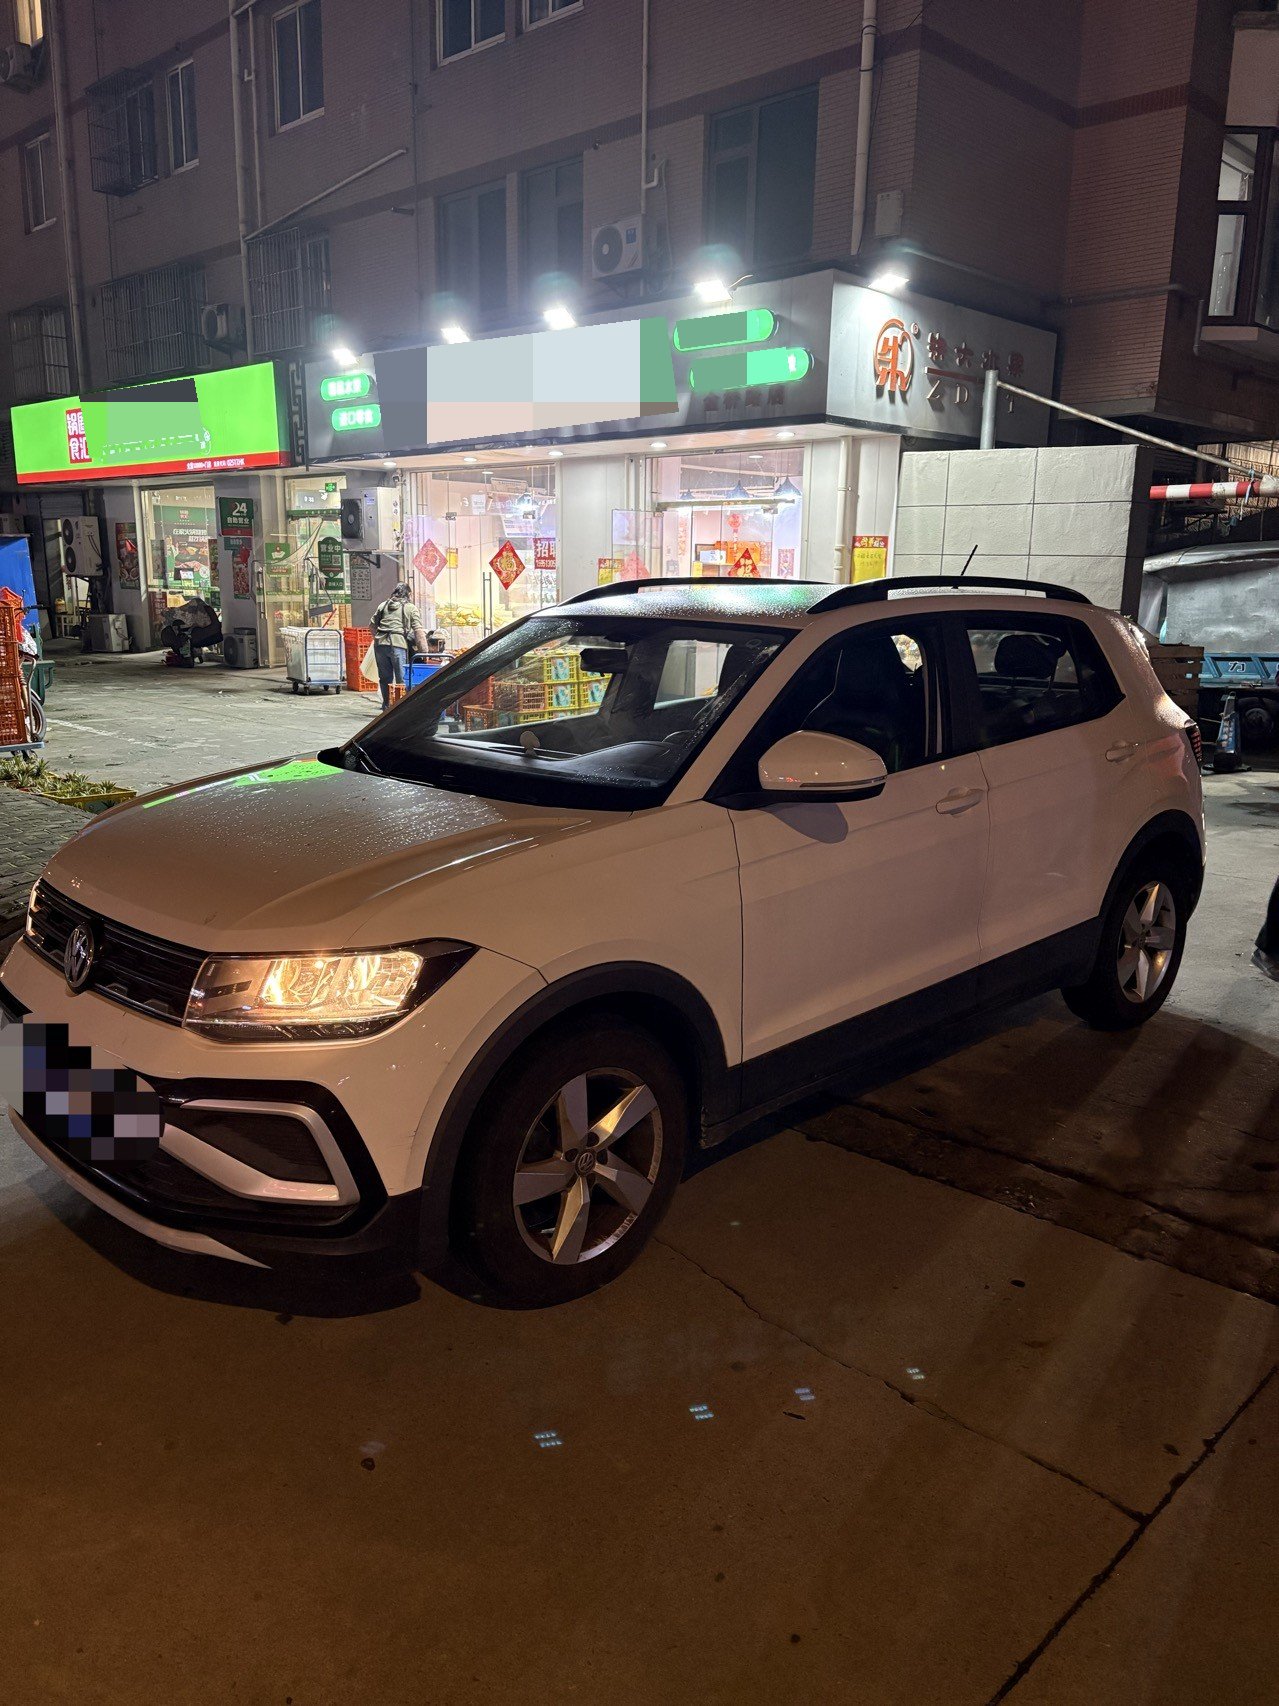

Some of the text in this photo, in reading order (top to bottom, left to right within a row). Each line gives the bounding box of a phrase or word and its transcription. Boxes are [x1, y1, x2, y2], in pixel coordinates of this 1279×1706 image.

[232, 502, 248, 516] 24
[320, 544, 341, 553] 营业中
